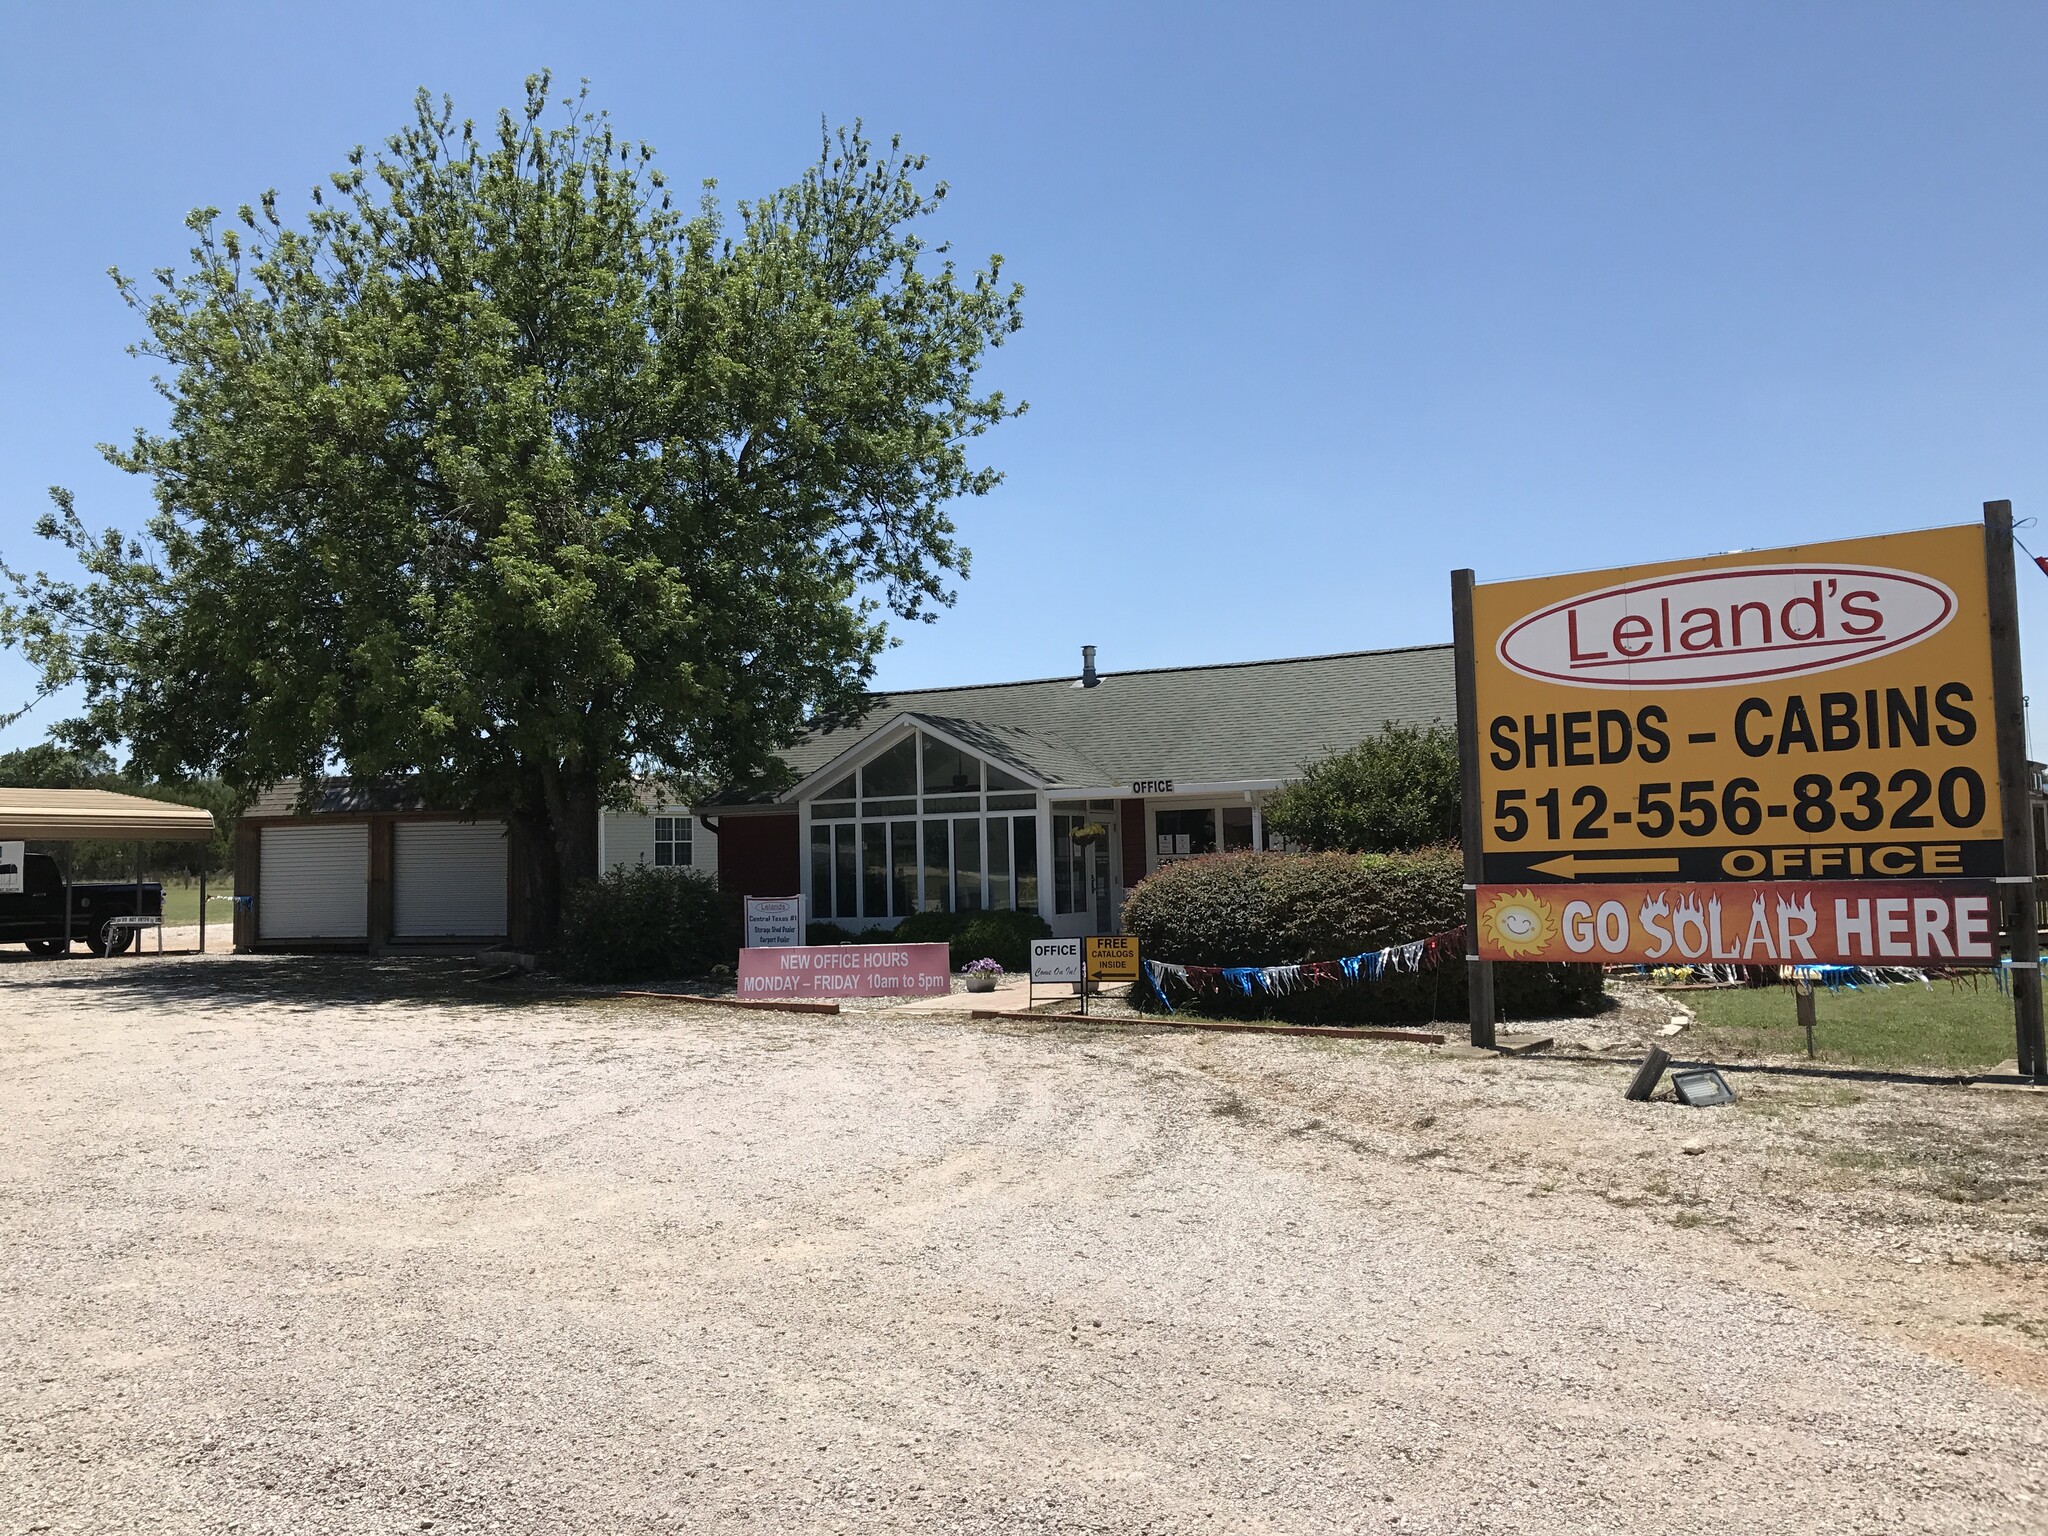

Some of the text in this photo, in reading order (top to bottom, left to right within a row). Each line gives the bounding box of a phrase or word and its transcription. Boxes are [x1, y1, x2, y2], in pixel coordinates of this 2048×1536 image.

[1568, 578, 1885, 662] Leland's
[1490, 705, 1671, 771] SHEDS
[1734, 682, 1977, 758] CABINS
[1133, 781, 1173, 793] OFFICE
[1493, 766, 1986, 842] 512-556-8320
[1721, 846, 1964, 877] OFFICE
[1561, 889, 1993, 960] GO SOLAR HERE
[1034, 944, 1077, 957] OFFICE
[1097, 938, 1128, 949] FREE
[780, 952, 909, 970] NEW OFFICE HOURS
[1091, 950, 1134, 958] CATALOGS
[1034, 966, 1078, 978] Come On In!
[1099, 961, 1127, 969] INSIDE
[744, 975, 801, 992] MONDAY
[814, 974, 861, 990] FRIDAY
[867, 974, 899, 989] 10am
[902, 974, 915, 988] to
[918, 973, 944, 991] 5pm
